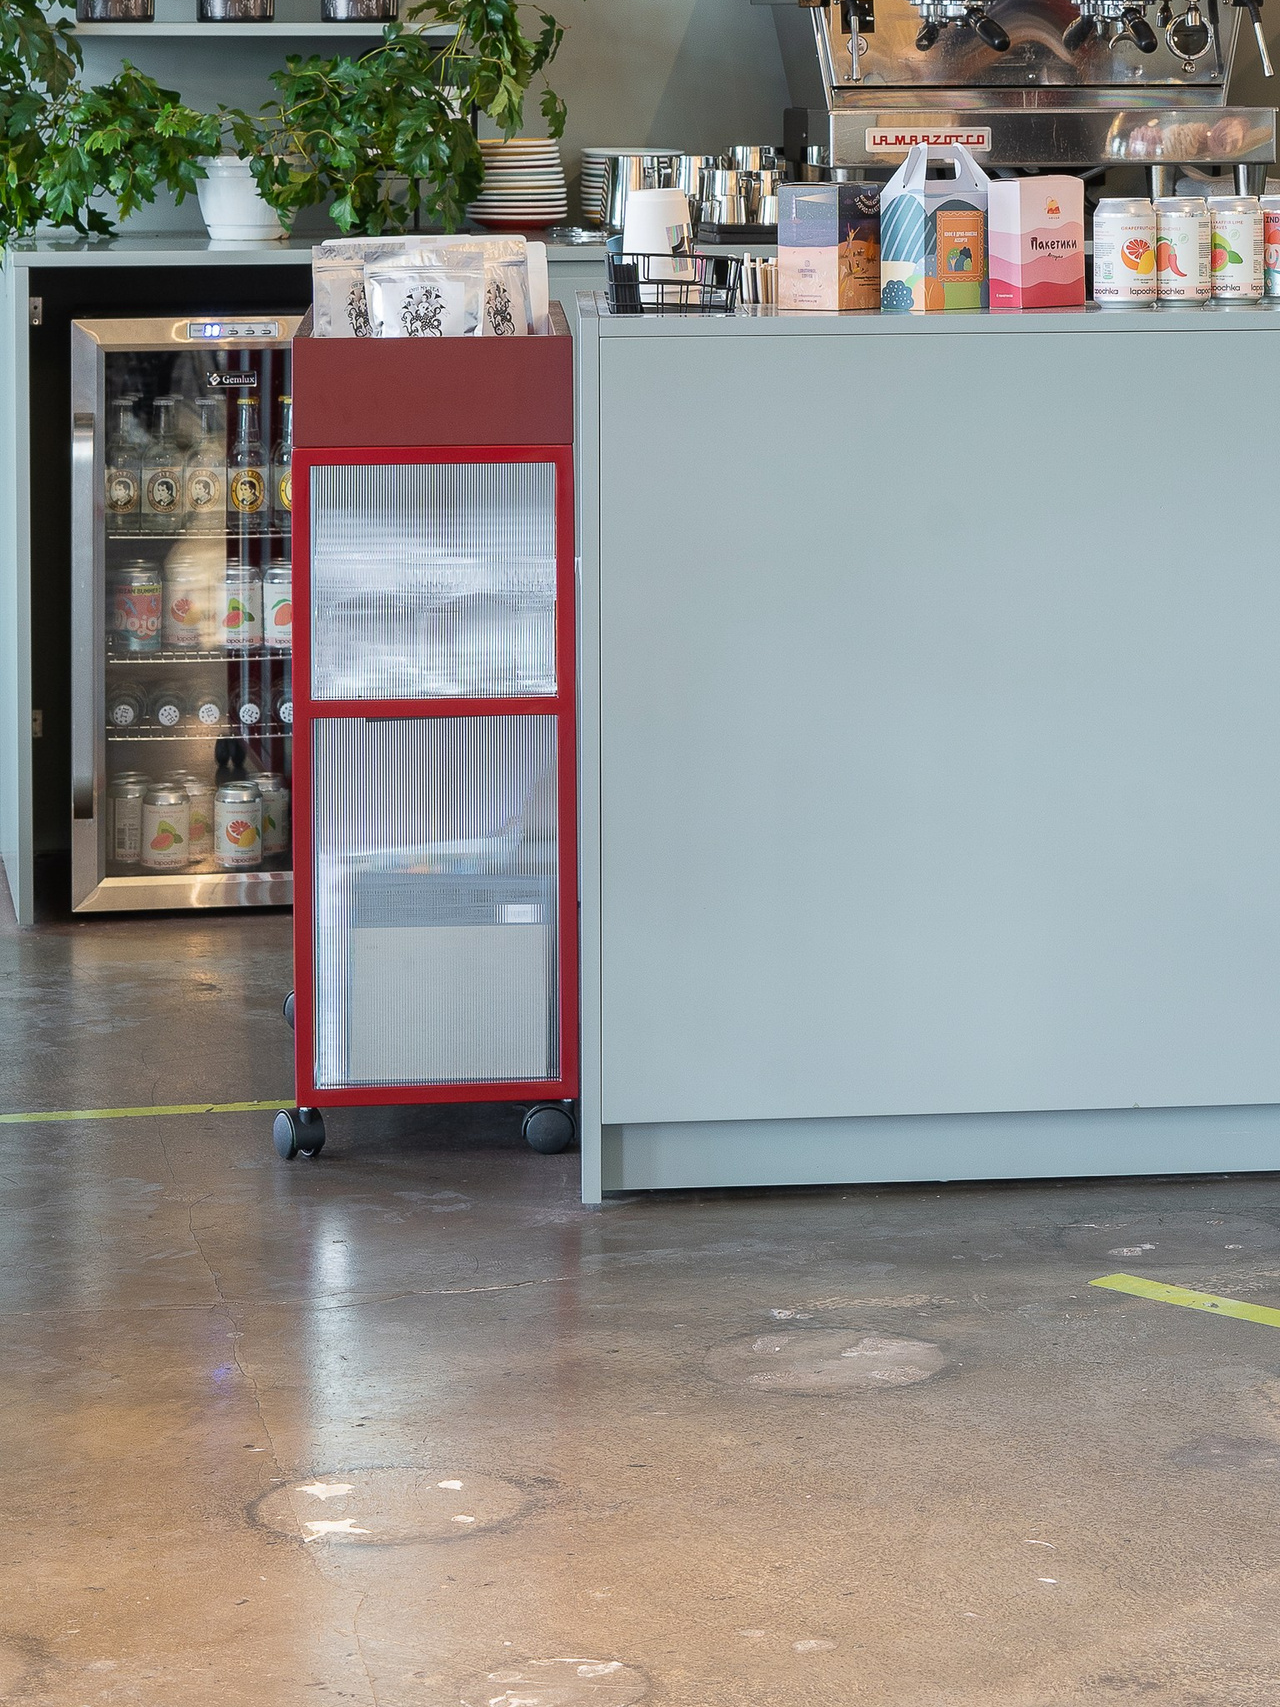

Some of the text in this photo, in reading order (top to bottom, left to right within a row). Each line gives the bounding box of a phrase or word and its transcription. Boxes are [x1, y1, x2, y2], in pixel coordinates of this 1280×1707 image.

[1030, 236, 1077, 251] Пакетики
[1157, 287, 1185, 296] pochka
[1212, 284, 1241, 294] pochka
[222, 375, 256, 384] Gemlux
[175, 635, 199, 643] lapoch
